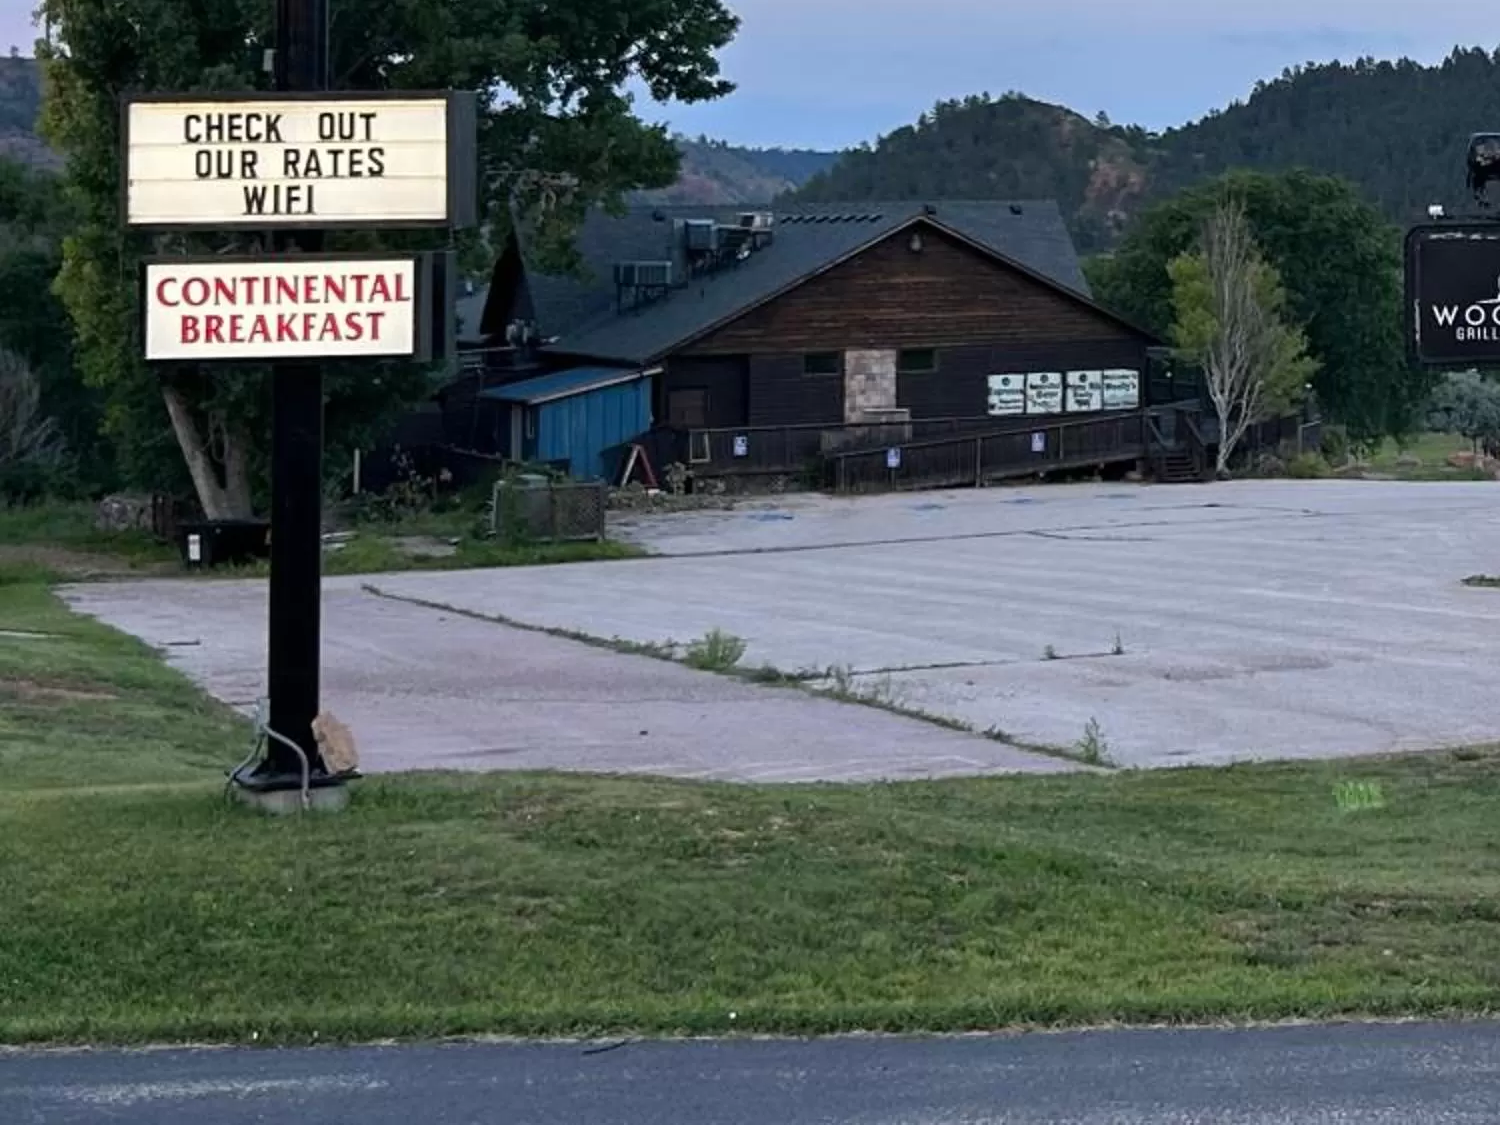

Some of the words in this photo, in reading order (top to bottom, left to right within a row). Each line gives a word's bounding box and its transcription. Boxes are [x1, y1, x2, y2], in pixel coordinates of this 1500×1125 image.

[184, 113, 283, 143] CHECK
[318, 112, 377, 141] OUT
[195, 149, 258, 178] OUR
[283, 147, 385, 177] RATES
[242, 184, 316, 215] WIFI
[156, 273, 411, 307] CONTINENTAL
[180, 311, 386, 344] BREAKFAST
[1455, 326, 1499, 341] GRILL
